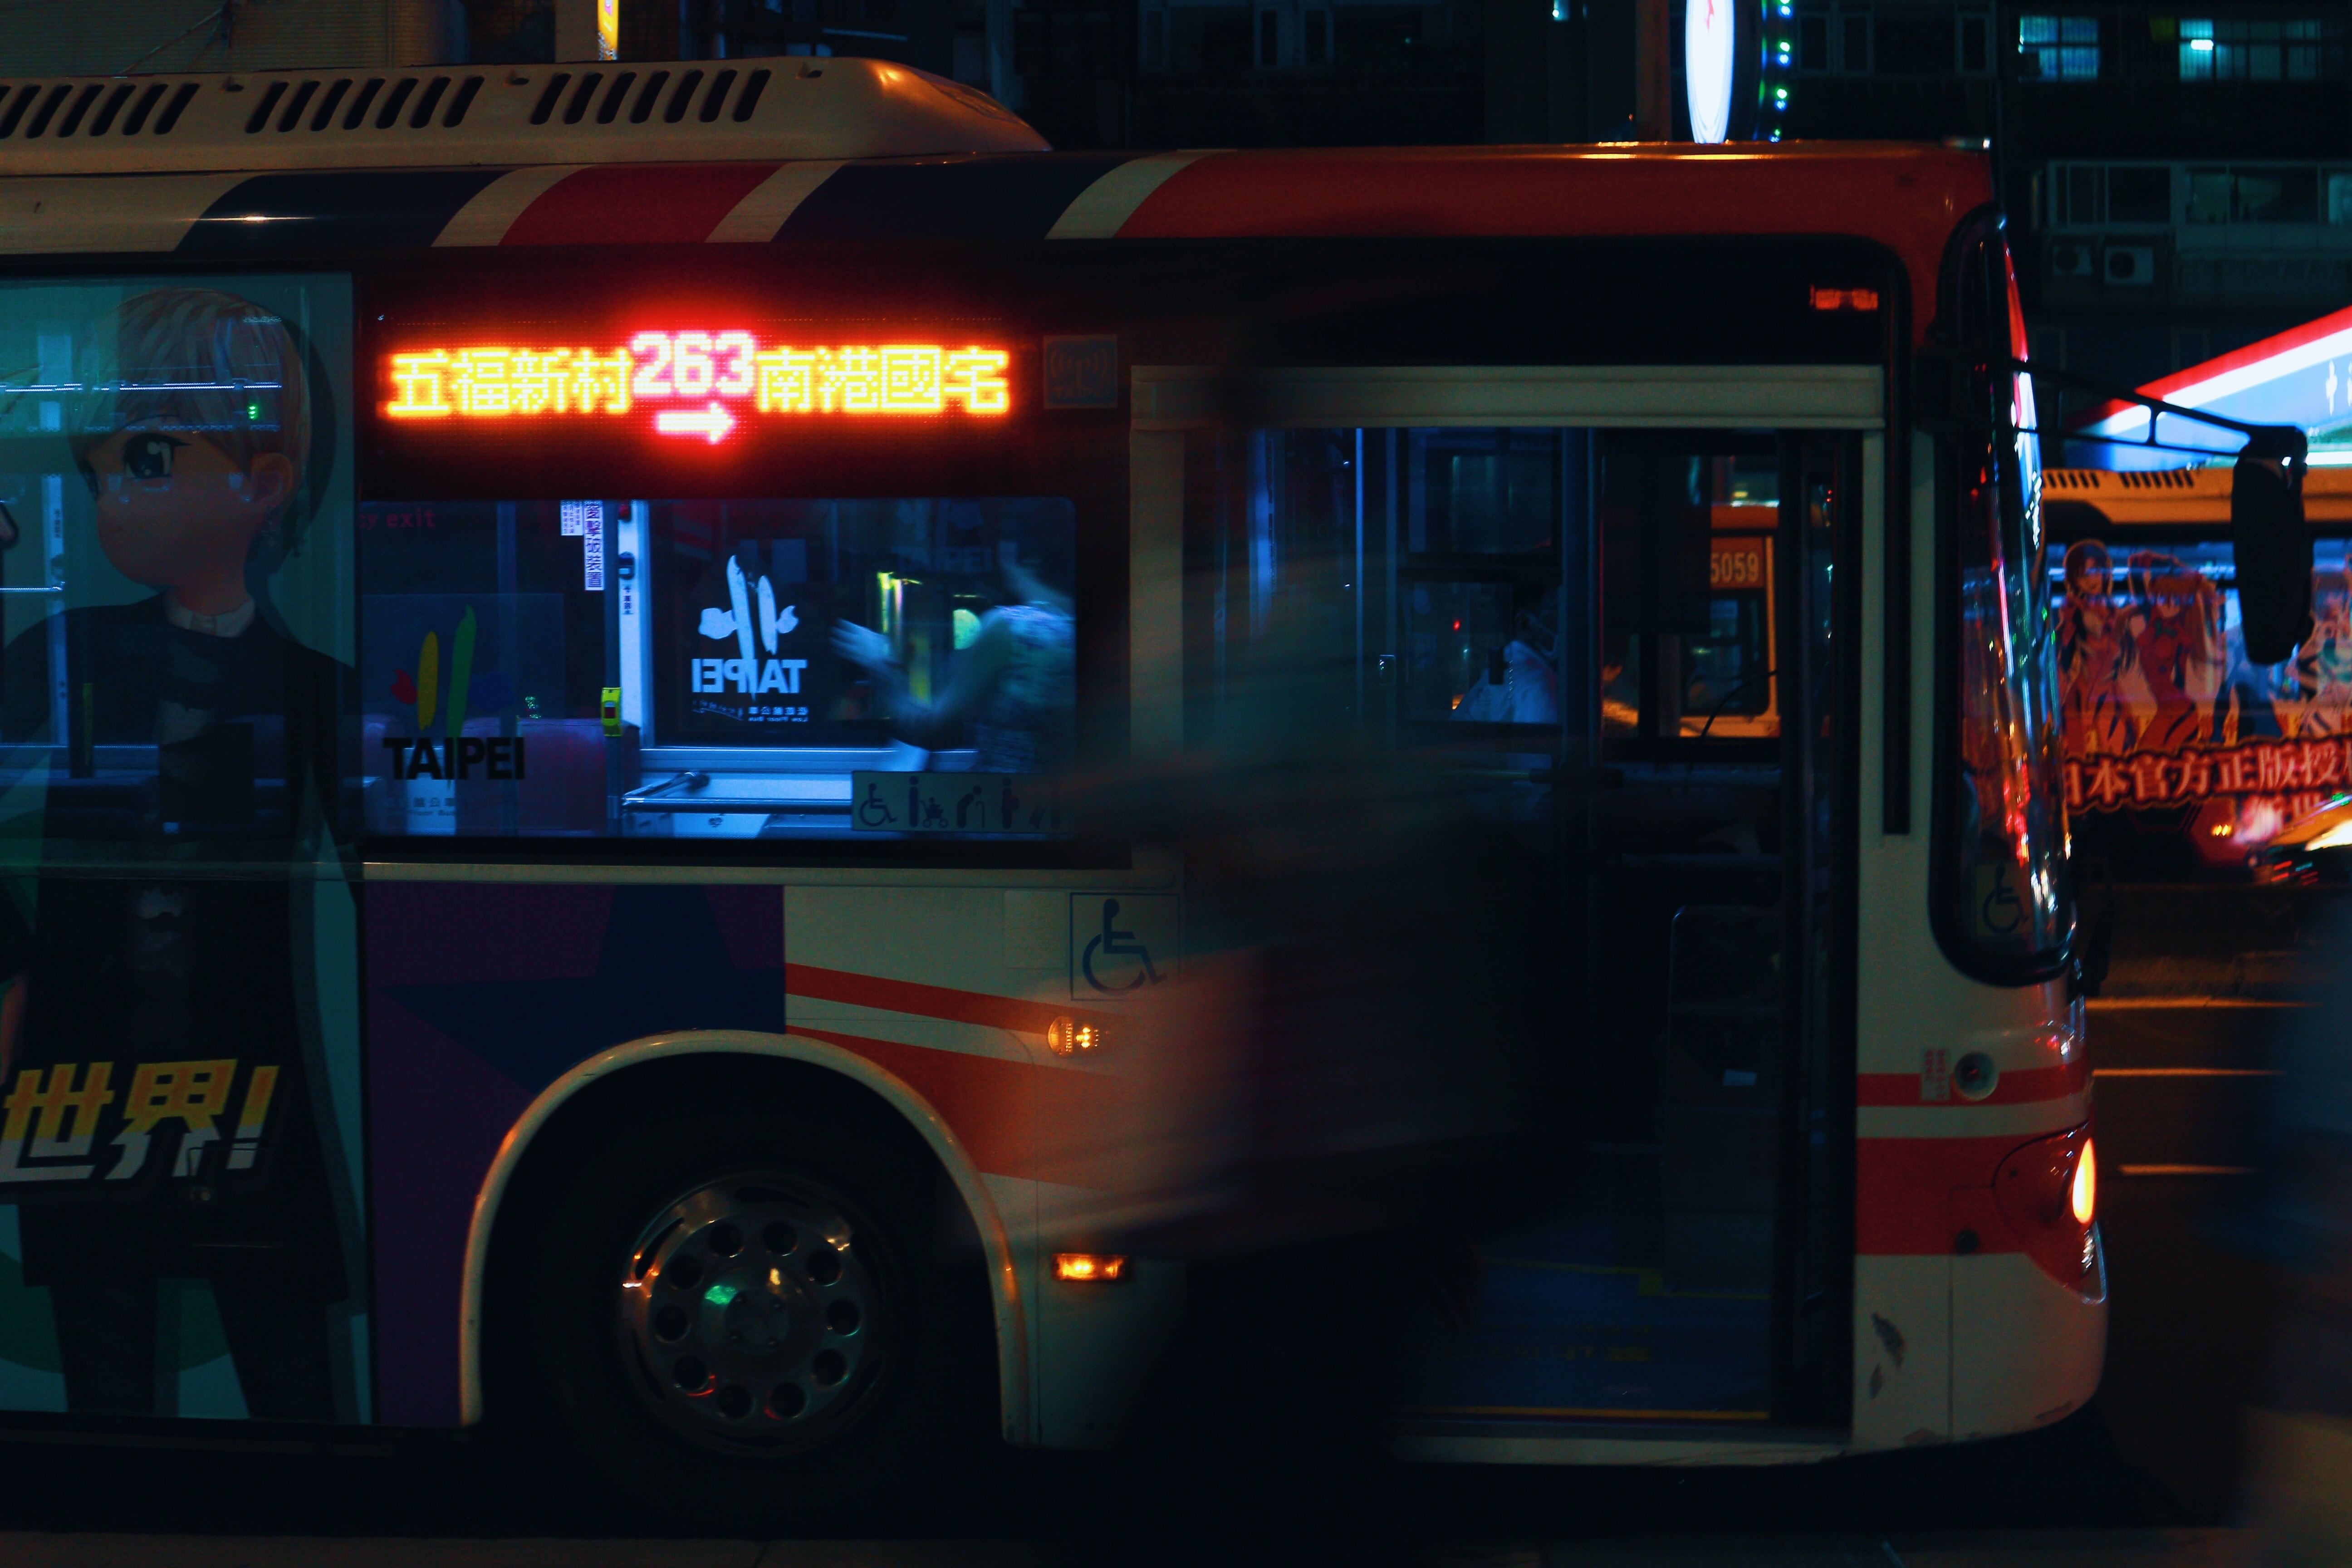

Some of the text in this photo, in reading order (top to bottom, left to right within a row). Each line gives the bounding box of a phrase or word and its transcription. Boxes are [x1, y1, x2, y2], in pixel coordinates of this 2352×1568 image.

[388, 330, 1008, 414] 五福新村 263 南港國宅
[387, 508, 436, 528] exit
[1710, 550, 1759, 583] 5059
[383, 736, 524, 780] TAIPEI
[2065, 740, 2352, 808] 日本官方正版授
[0, 1058, 280, 1182] 世界!
